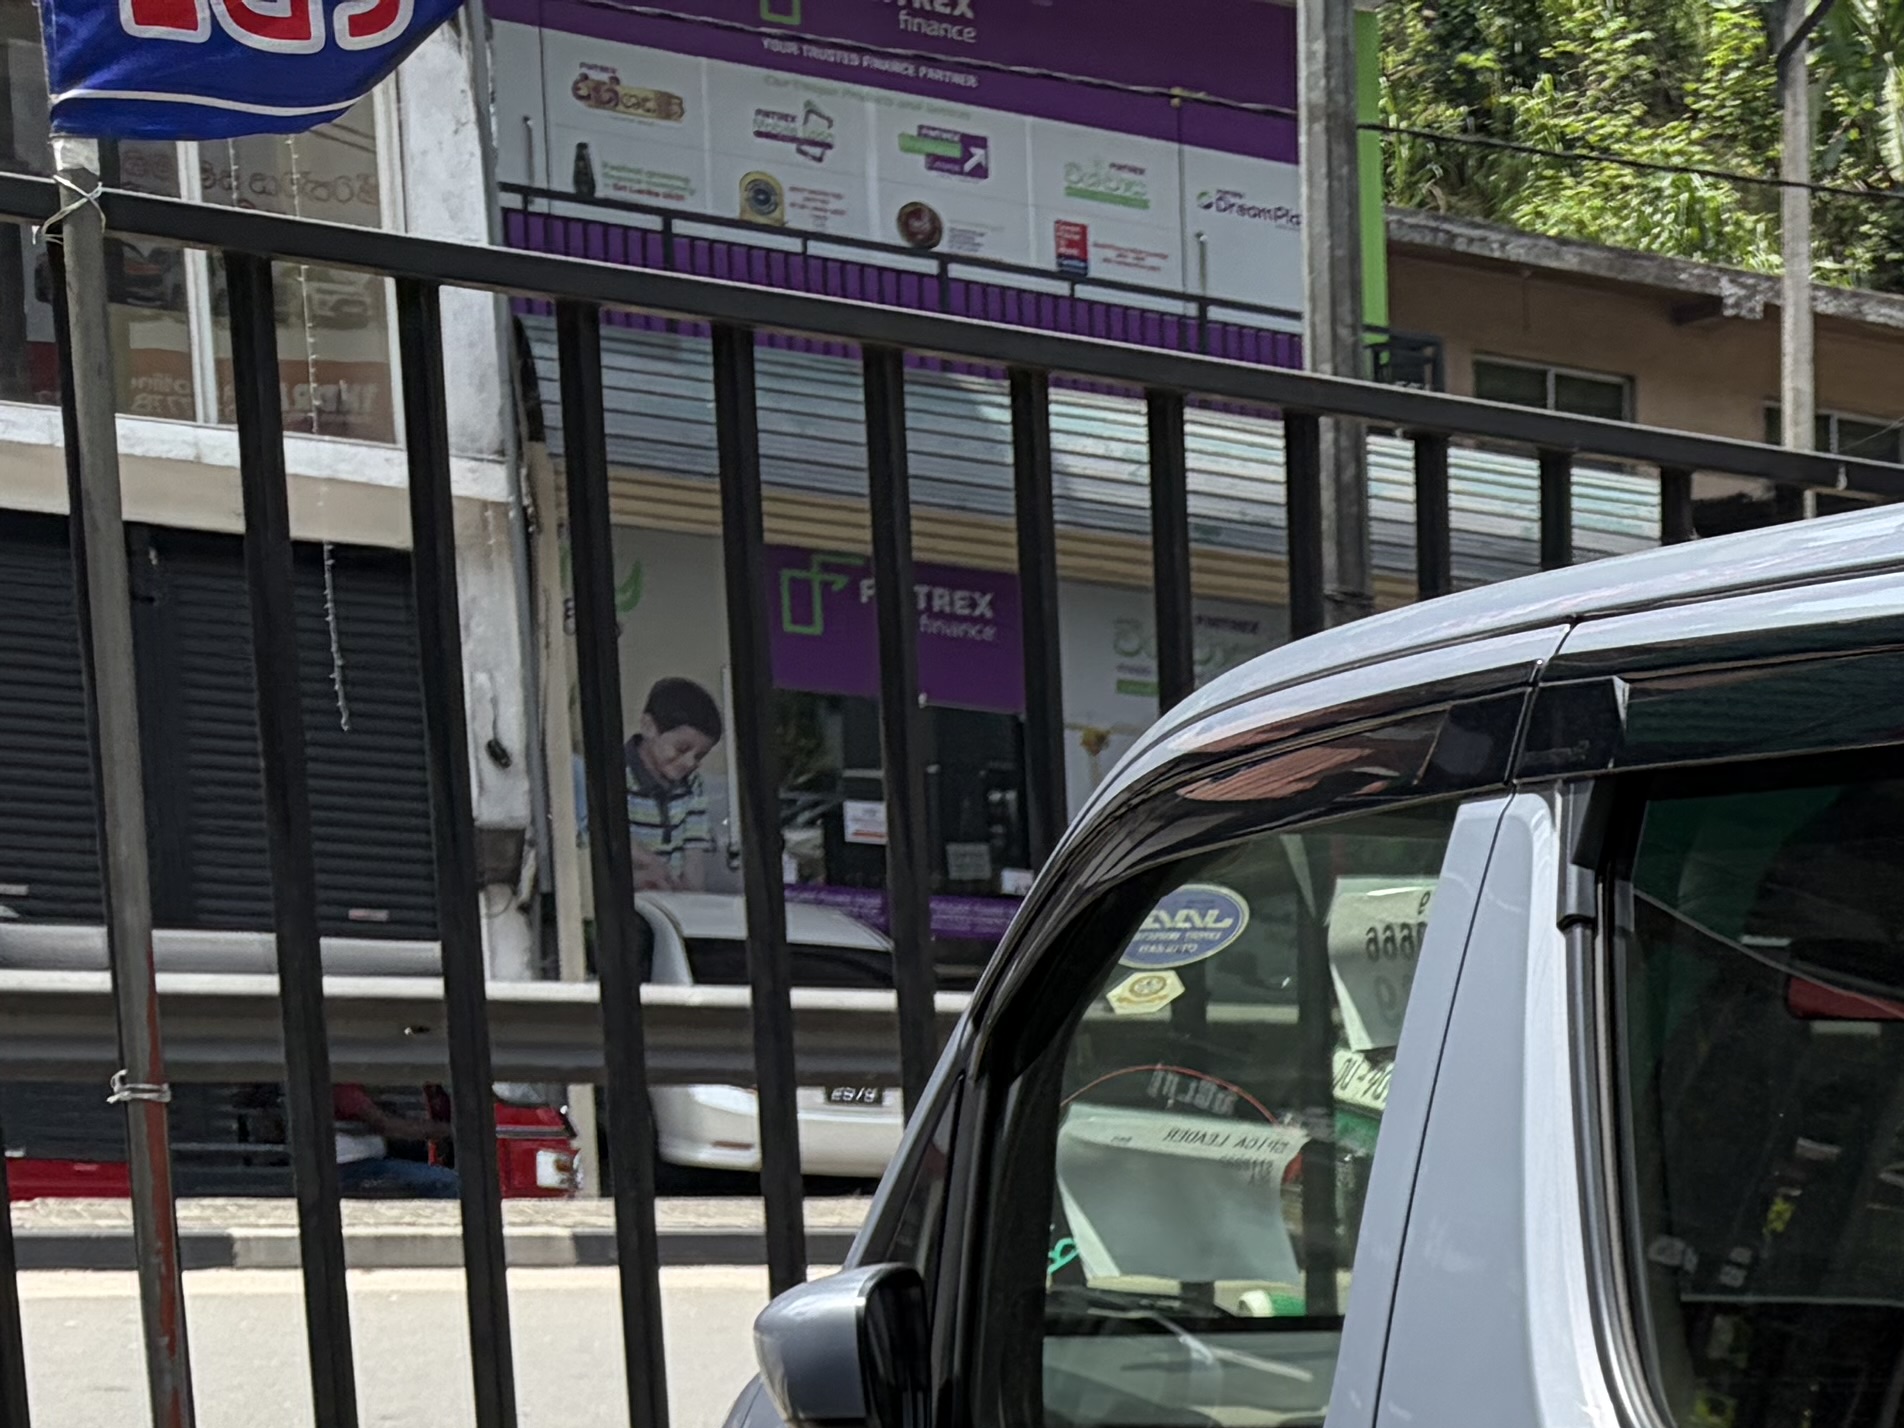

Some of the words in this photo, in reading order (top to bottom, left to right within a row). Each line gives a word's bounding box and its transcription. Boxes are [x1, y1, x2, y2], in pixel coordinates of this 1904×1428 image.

[899, 9, 977, 43] finance
[918, 66, 979, 88] PARTNER
[1215, 195, 1301, 226] DreamPla
[859, 578, 995, 620] FTREX
[918, 613, 996, 643] finance
